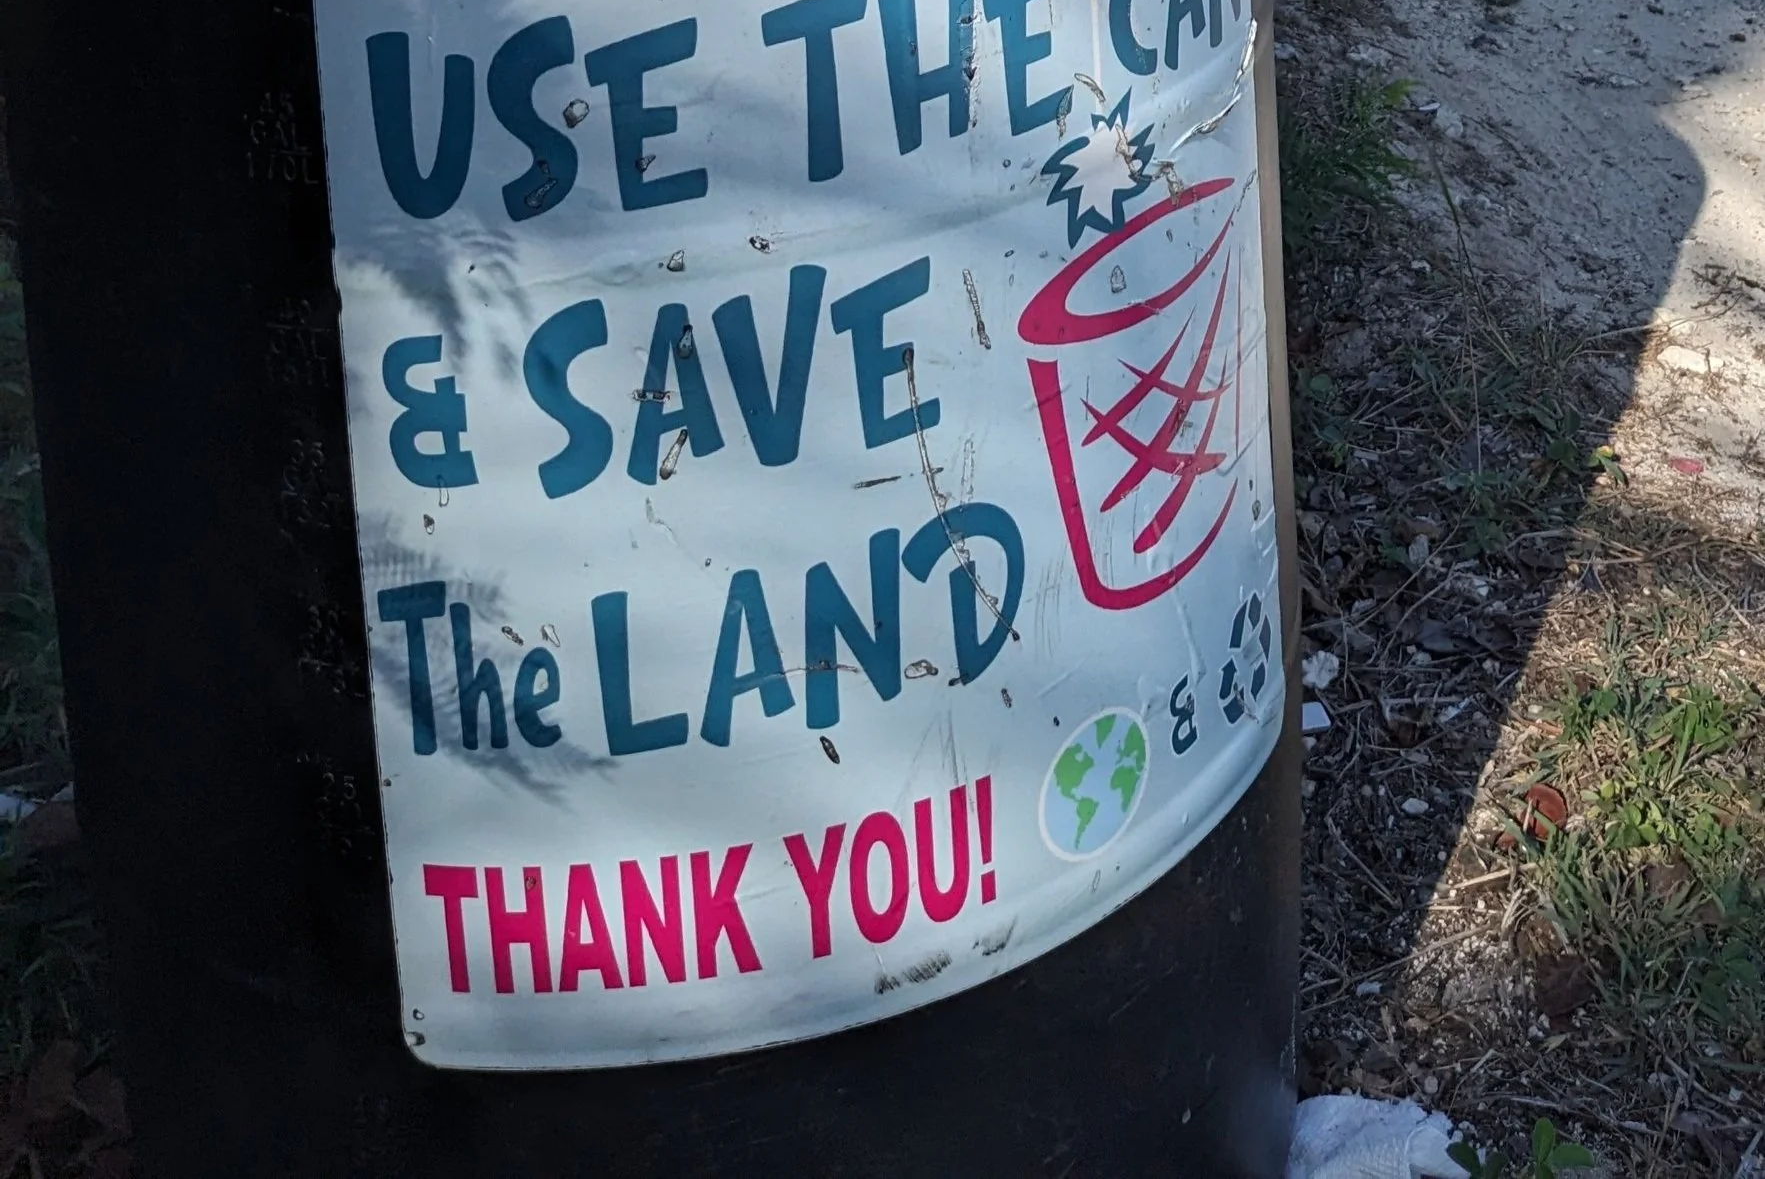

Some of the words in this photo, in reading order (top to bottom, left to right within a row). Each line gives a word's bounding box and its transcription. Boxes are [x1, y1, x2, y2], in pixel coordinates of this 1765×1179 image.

[366, 15, 708, 222] USE
[382, 335, 478, 488] &
[523, 256, 941, 498] SAVE
[378, 581, 560, 756] The
[591, 502, 1025, 756] LAND
[423, 843, 762, 995] THANK
[783, 775, 997, 959] YOU!
